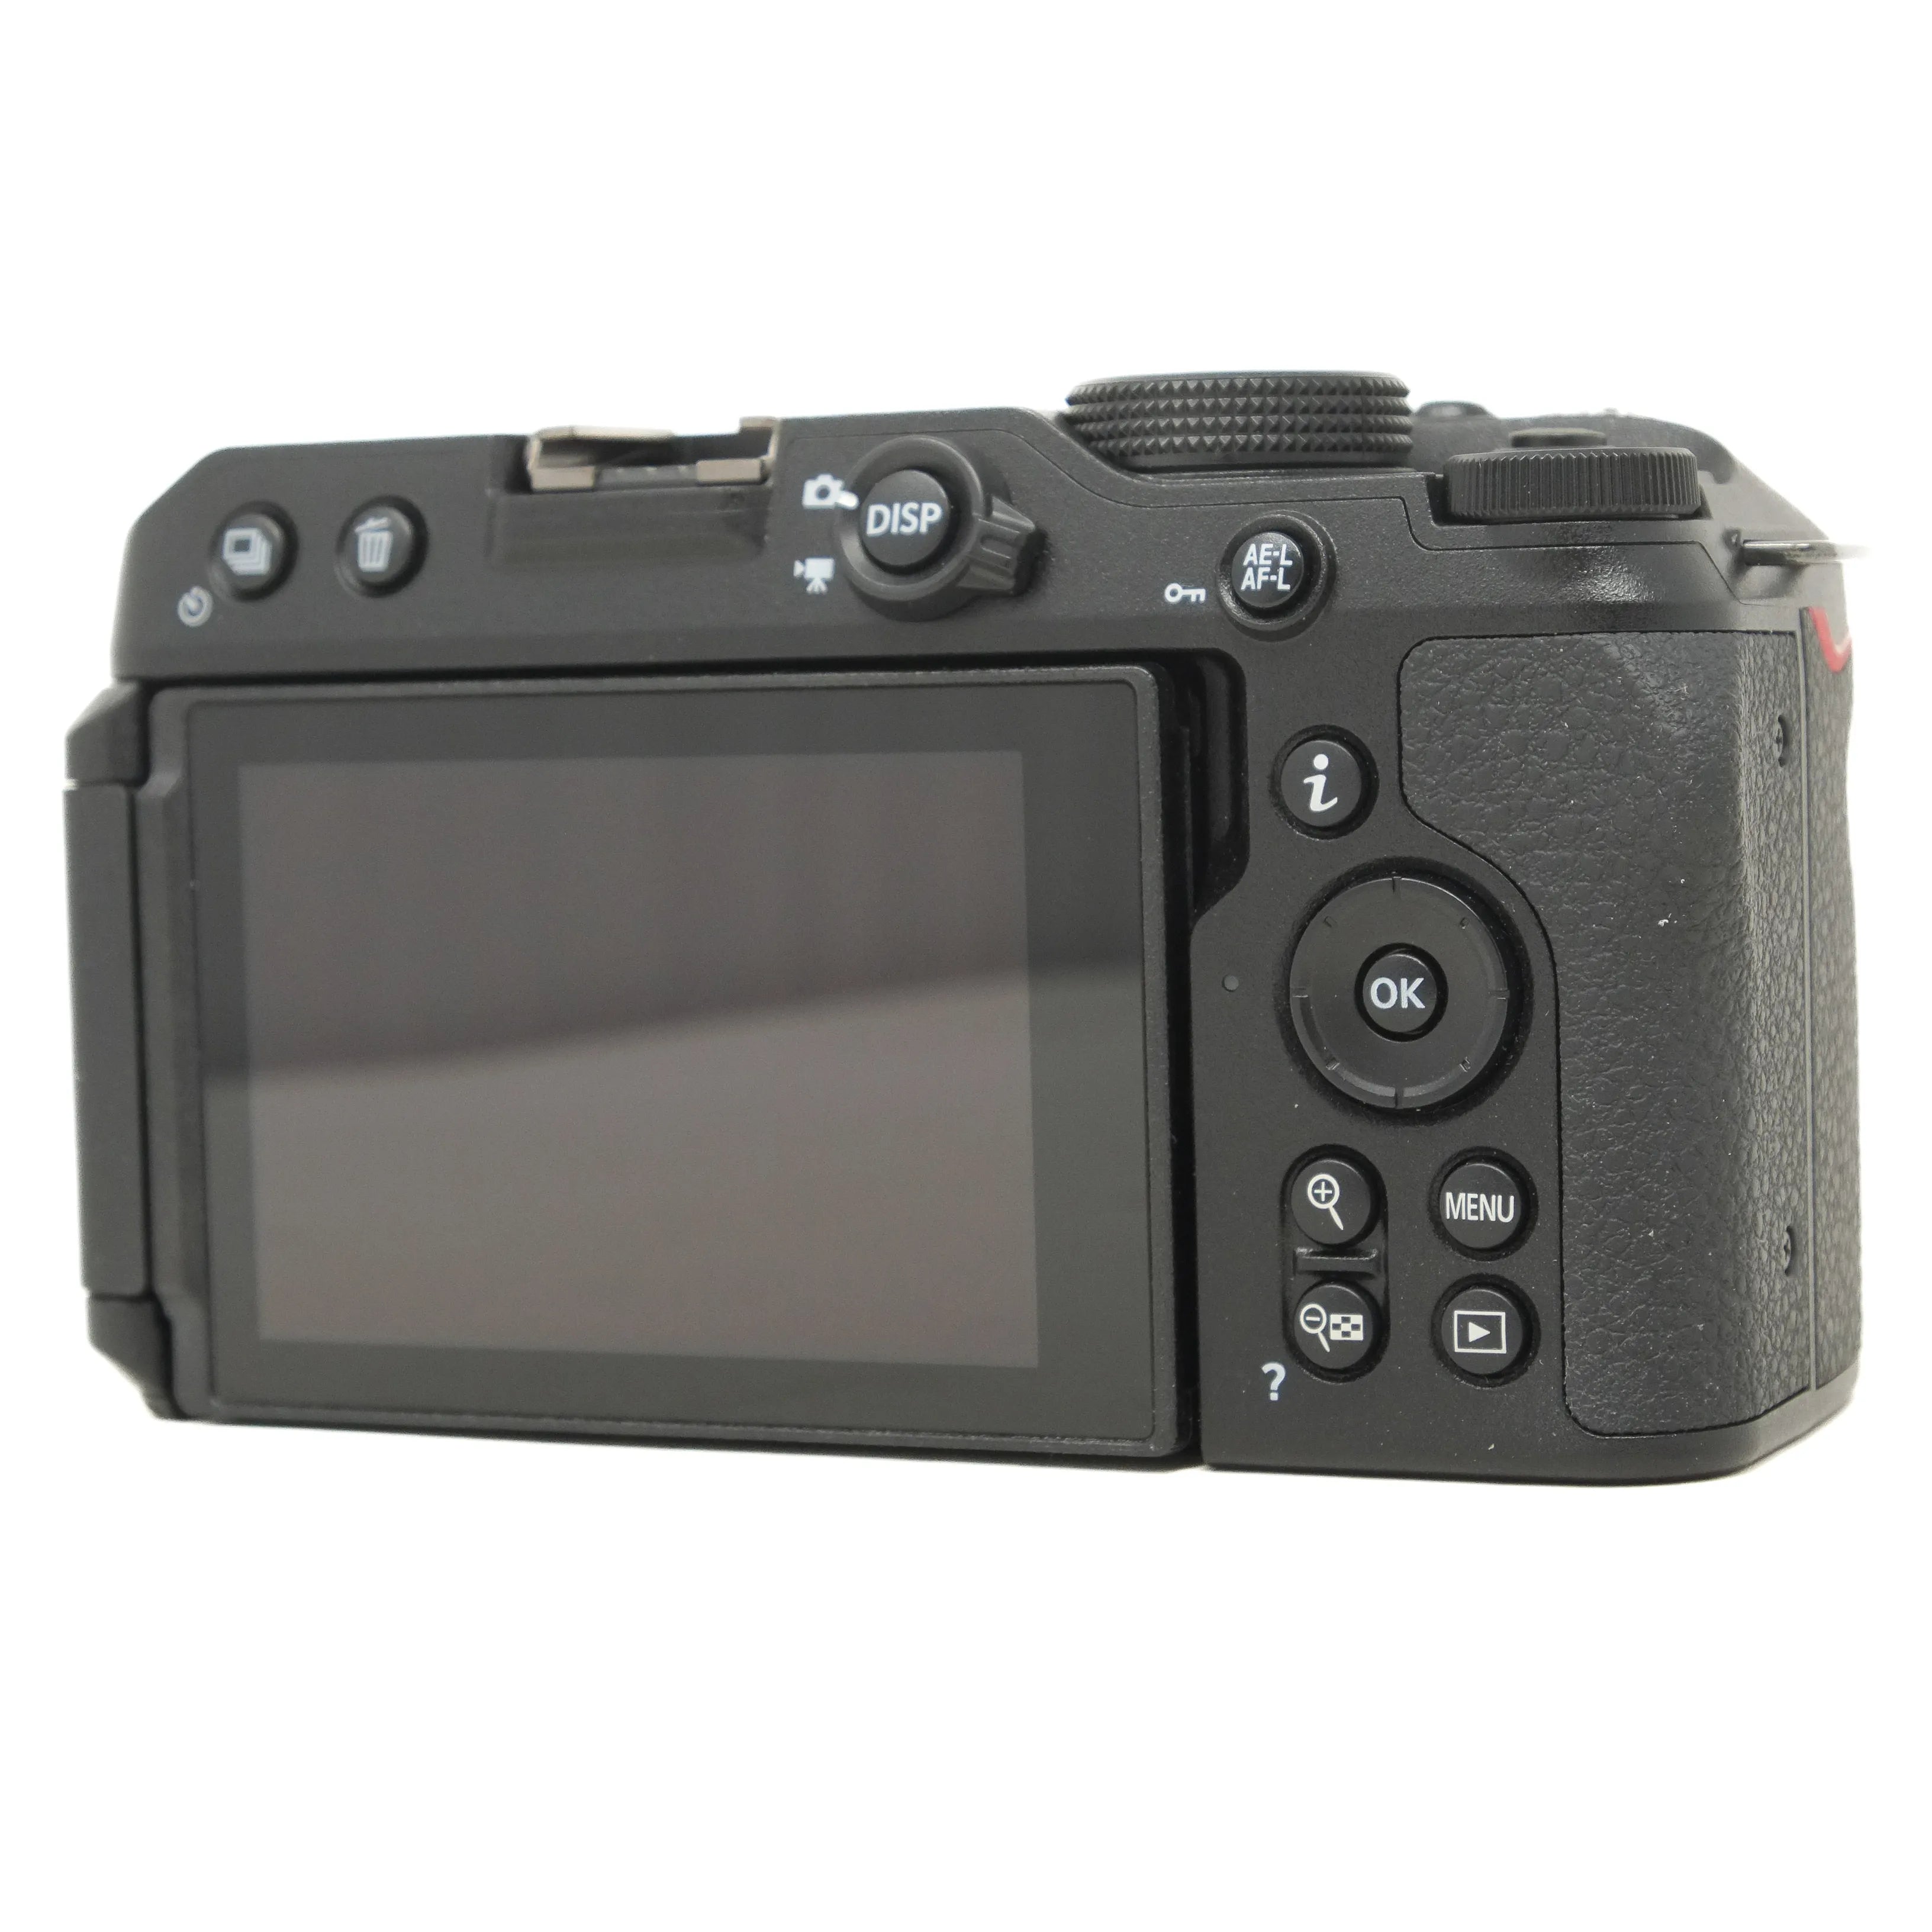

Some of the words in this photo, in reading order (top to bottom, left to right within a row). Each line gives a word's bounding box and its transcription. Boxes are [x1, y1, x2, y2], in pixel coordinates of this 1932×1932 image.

[866, 502, 943, 536] DISP
[1242, 543, 1293, 566] AE-L
[1240, 566, 1291, 591] AF-L
[1303, 754, 1338, 812] i
[1370, 977, 1425, 1009] OK
[1445, 1192, 1515, 1223] MENU
[1261, 1362, 1286, 1401] ?
